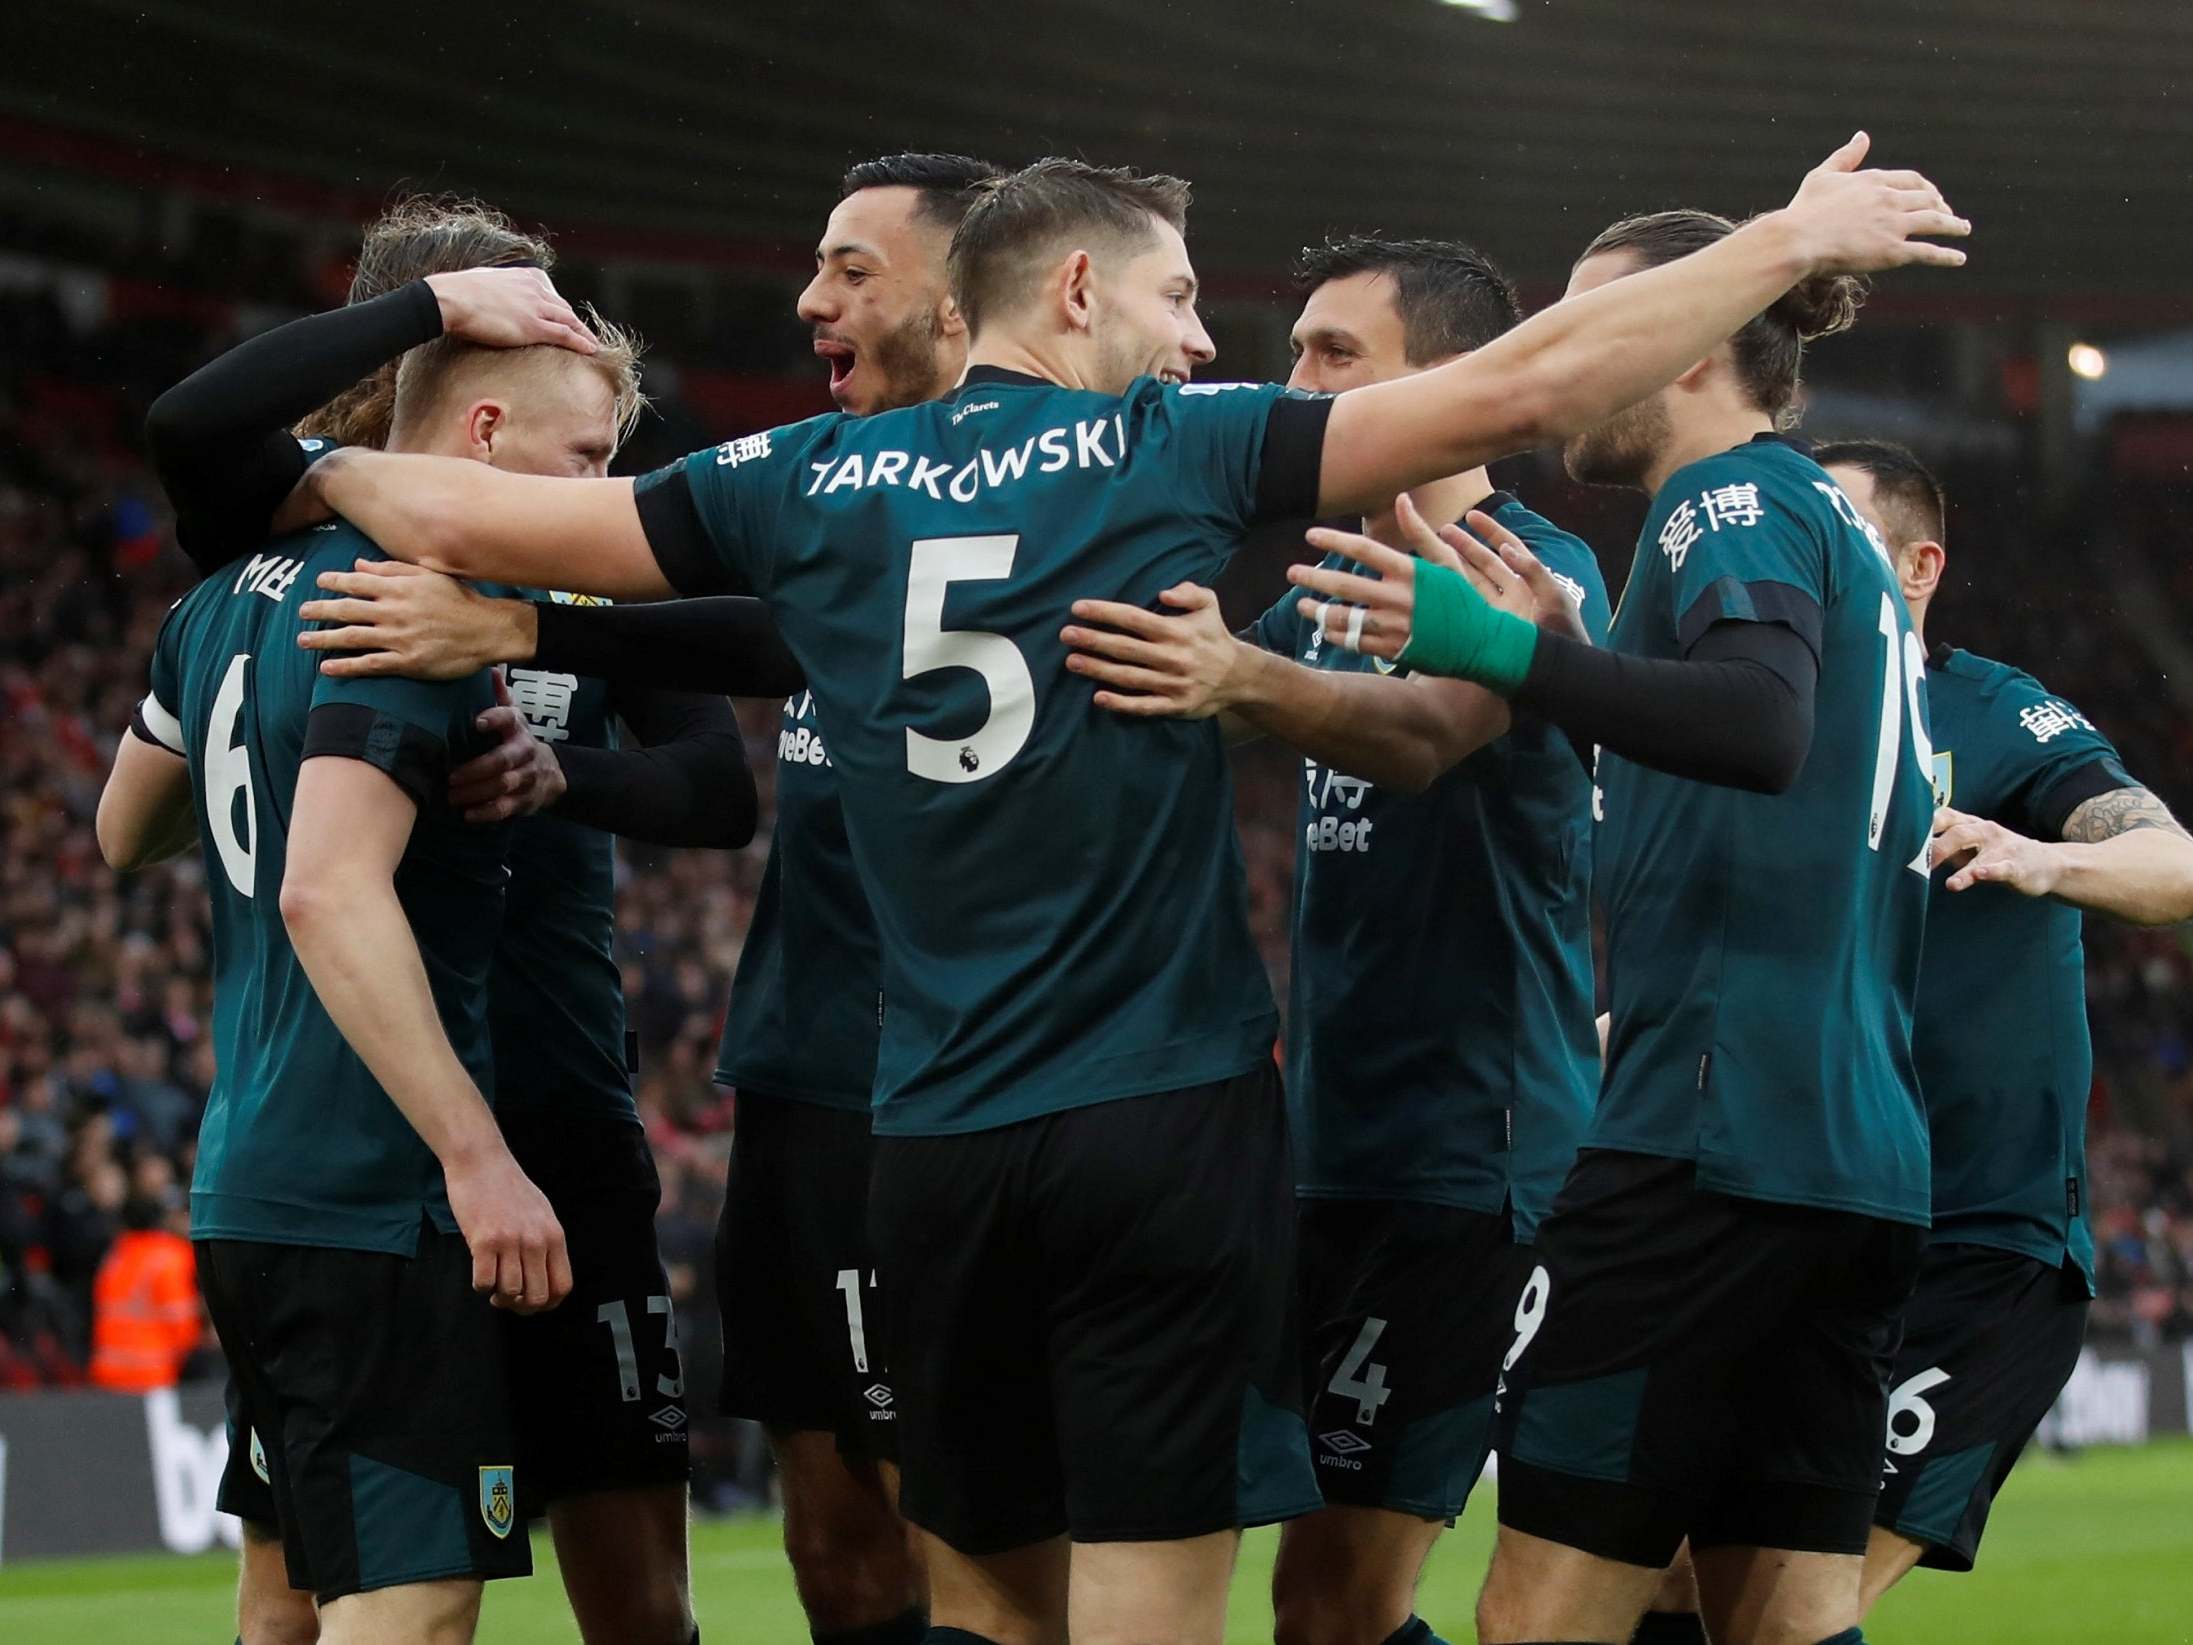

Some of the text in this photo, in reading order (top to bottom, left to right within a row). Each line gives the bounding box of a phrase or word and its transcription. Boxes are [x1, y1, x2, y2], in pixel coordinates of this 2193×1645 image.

[963, 402, 999, 415] Clarets
[806, 413, 1125, 503] TARKOWSKI
[903, 534, 1036, 784] 5
[204, 653, 258, 899] 6
[1306, 816, 1374, 852] eBet
[597, 1295, 685, 1402] 13
[1502, 1265, 1550, 1372] 9
[1327, 1316, 1392, 1427] 4
[1885, 1366, 1952, 1456] 6
[1319, 1453, 1363, 1471] umbro
